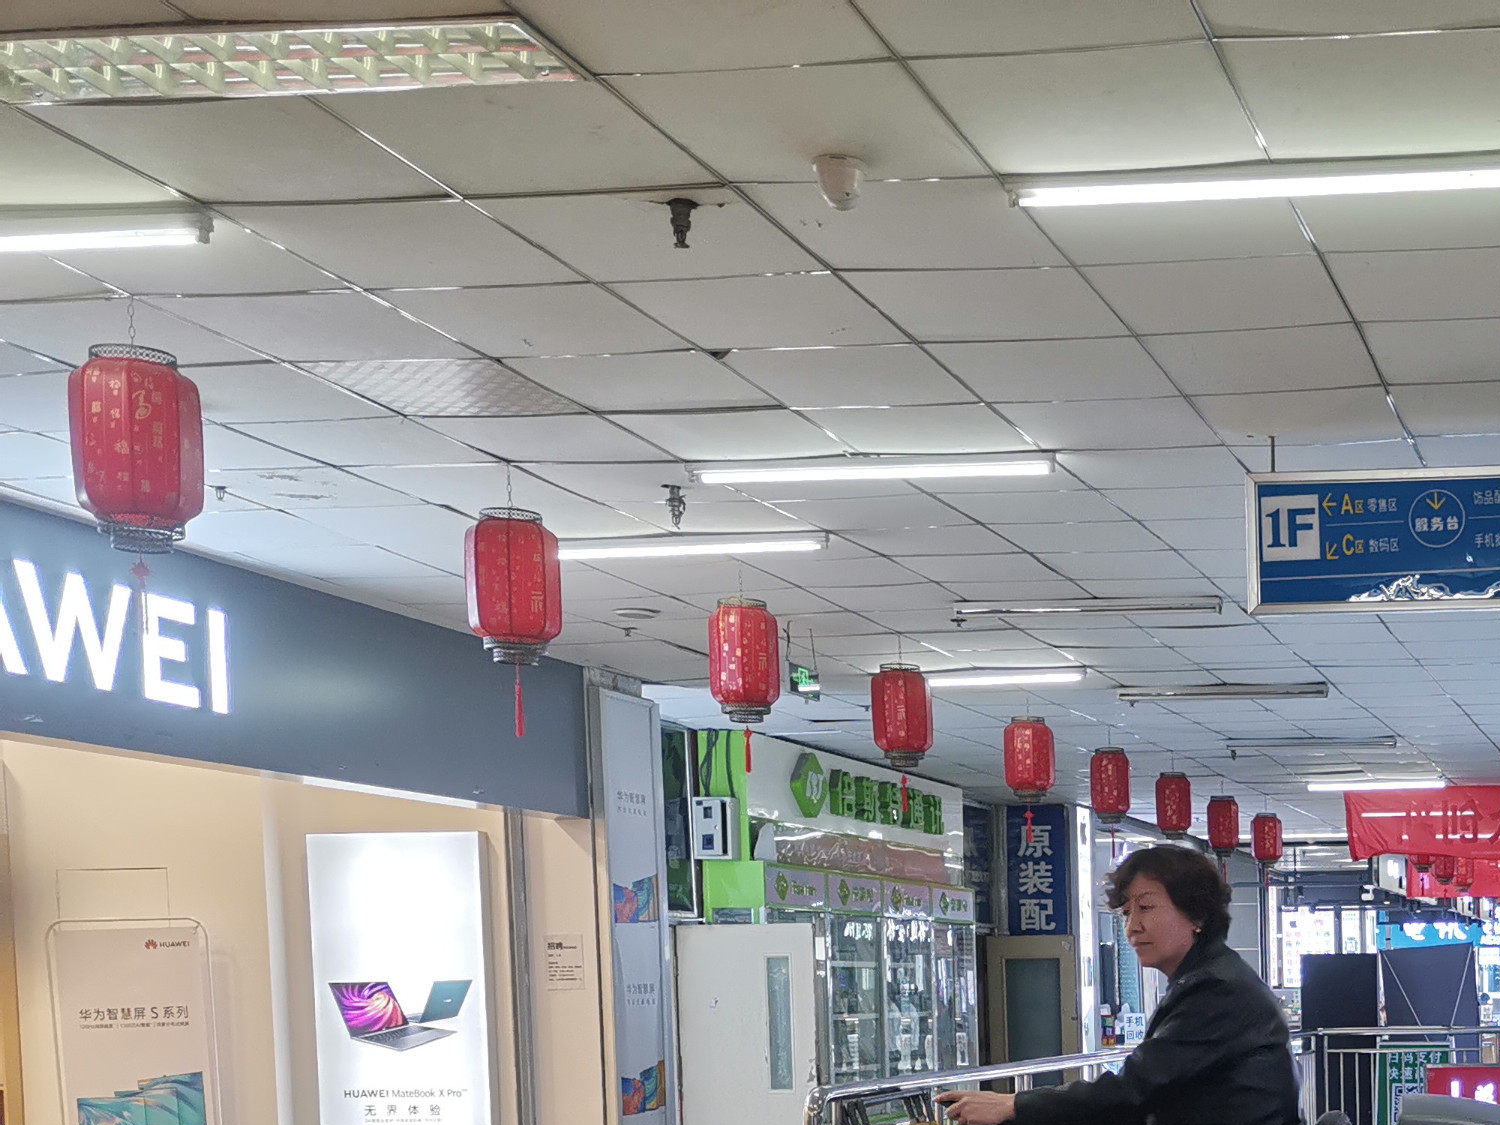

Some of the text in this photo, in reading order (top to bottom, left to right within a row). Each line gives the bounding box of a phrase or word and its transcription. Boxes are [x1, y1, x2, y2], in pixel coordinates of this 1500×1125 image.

[1266, 506, 1316, 549] 1F
[1414, 516, 1459, 532] 服务台
[1368, 538, 1399, 552] 数码区
[1016, 824, 1057, 932] 原装配
[159, 940, 190, 948] HUAWEI
[79, 1005, 190, 1021] 华为智慧屏 S 系列
[1125, 1016, 1144, 1027] 手机
[1126, 1030, 1145, 1042] 回收
[343, 1089, 389, 1098] HUAWEI
[391, 1088, 436, 1098] MateBook
[438, 1089, 445, 1097] X
[364, 1104, 441, 1117] 无界体验
